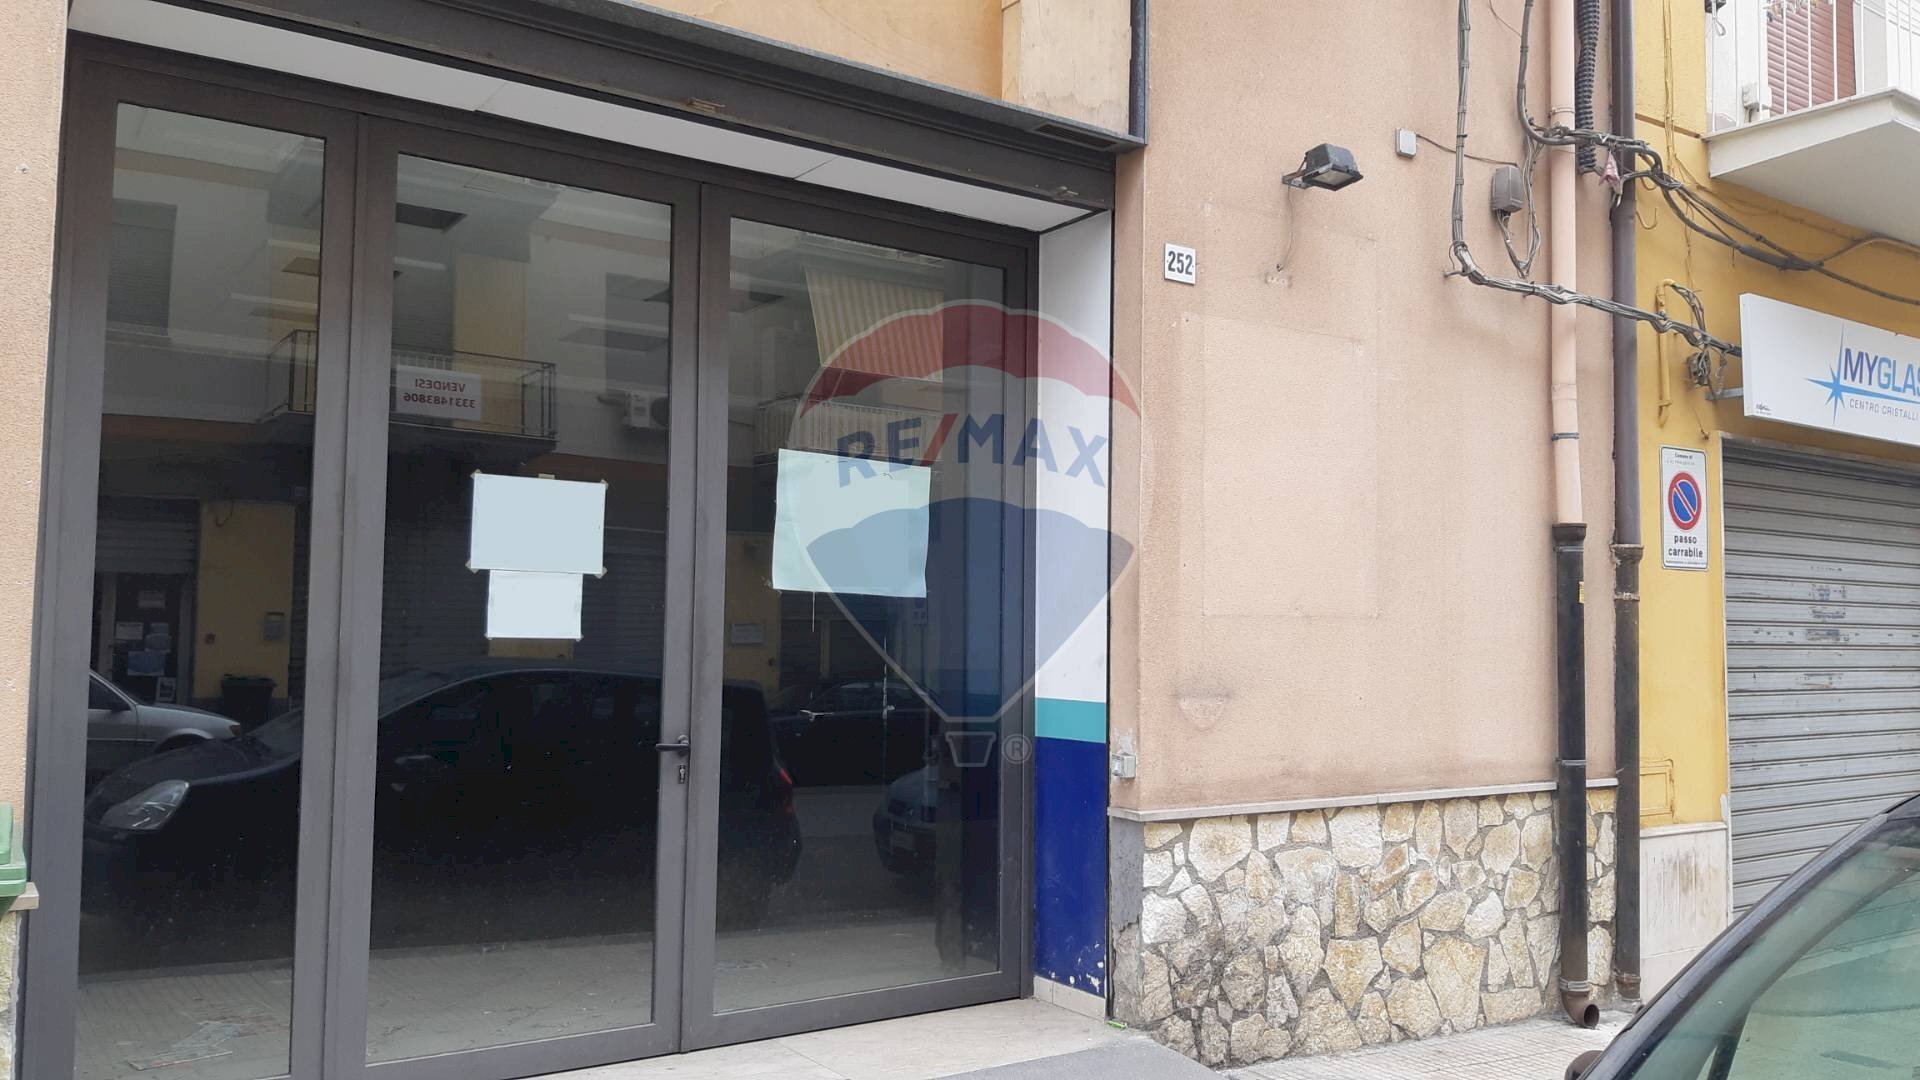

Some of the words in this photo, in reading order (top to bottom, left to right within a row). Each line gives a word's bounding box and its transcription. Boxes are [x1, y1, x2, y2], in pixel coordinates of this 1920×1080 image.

[1168, 251, 1193, 275] 252
[1844, 347, 1920, 397] MYGLA
[1849, 398, 1880, 413] CENTRO
[1882, 405, 1919, 421] CRISTALLI
[1674, 534, 1697, 545] passo
[1668, 547, 1703, 558] carrabile
